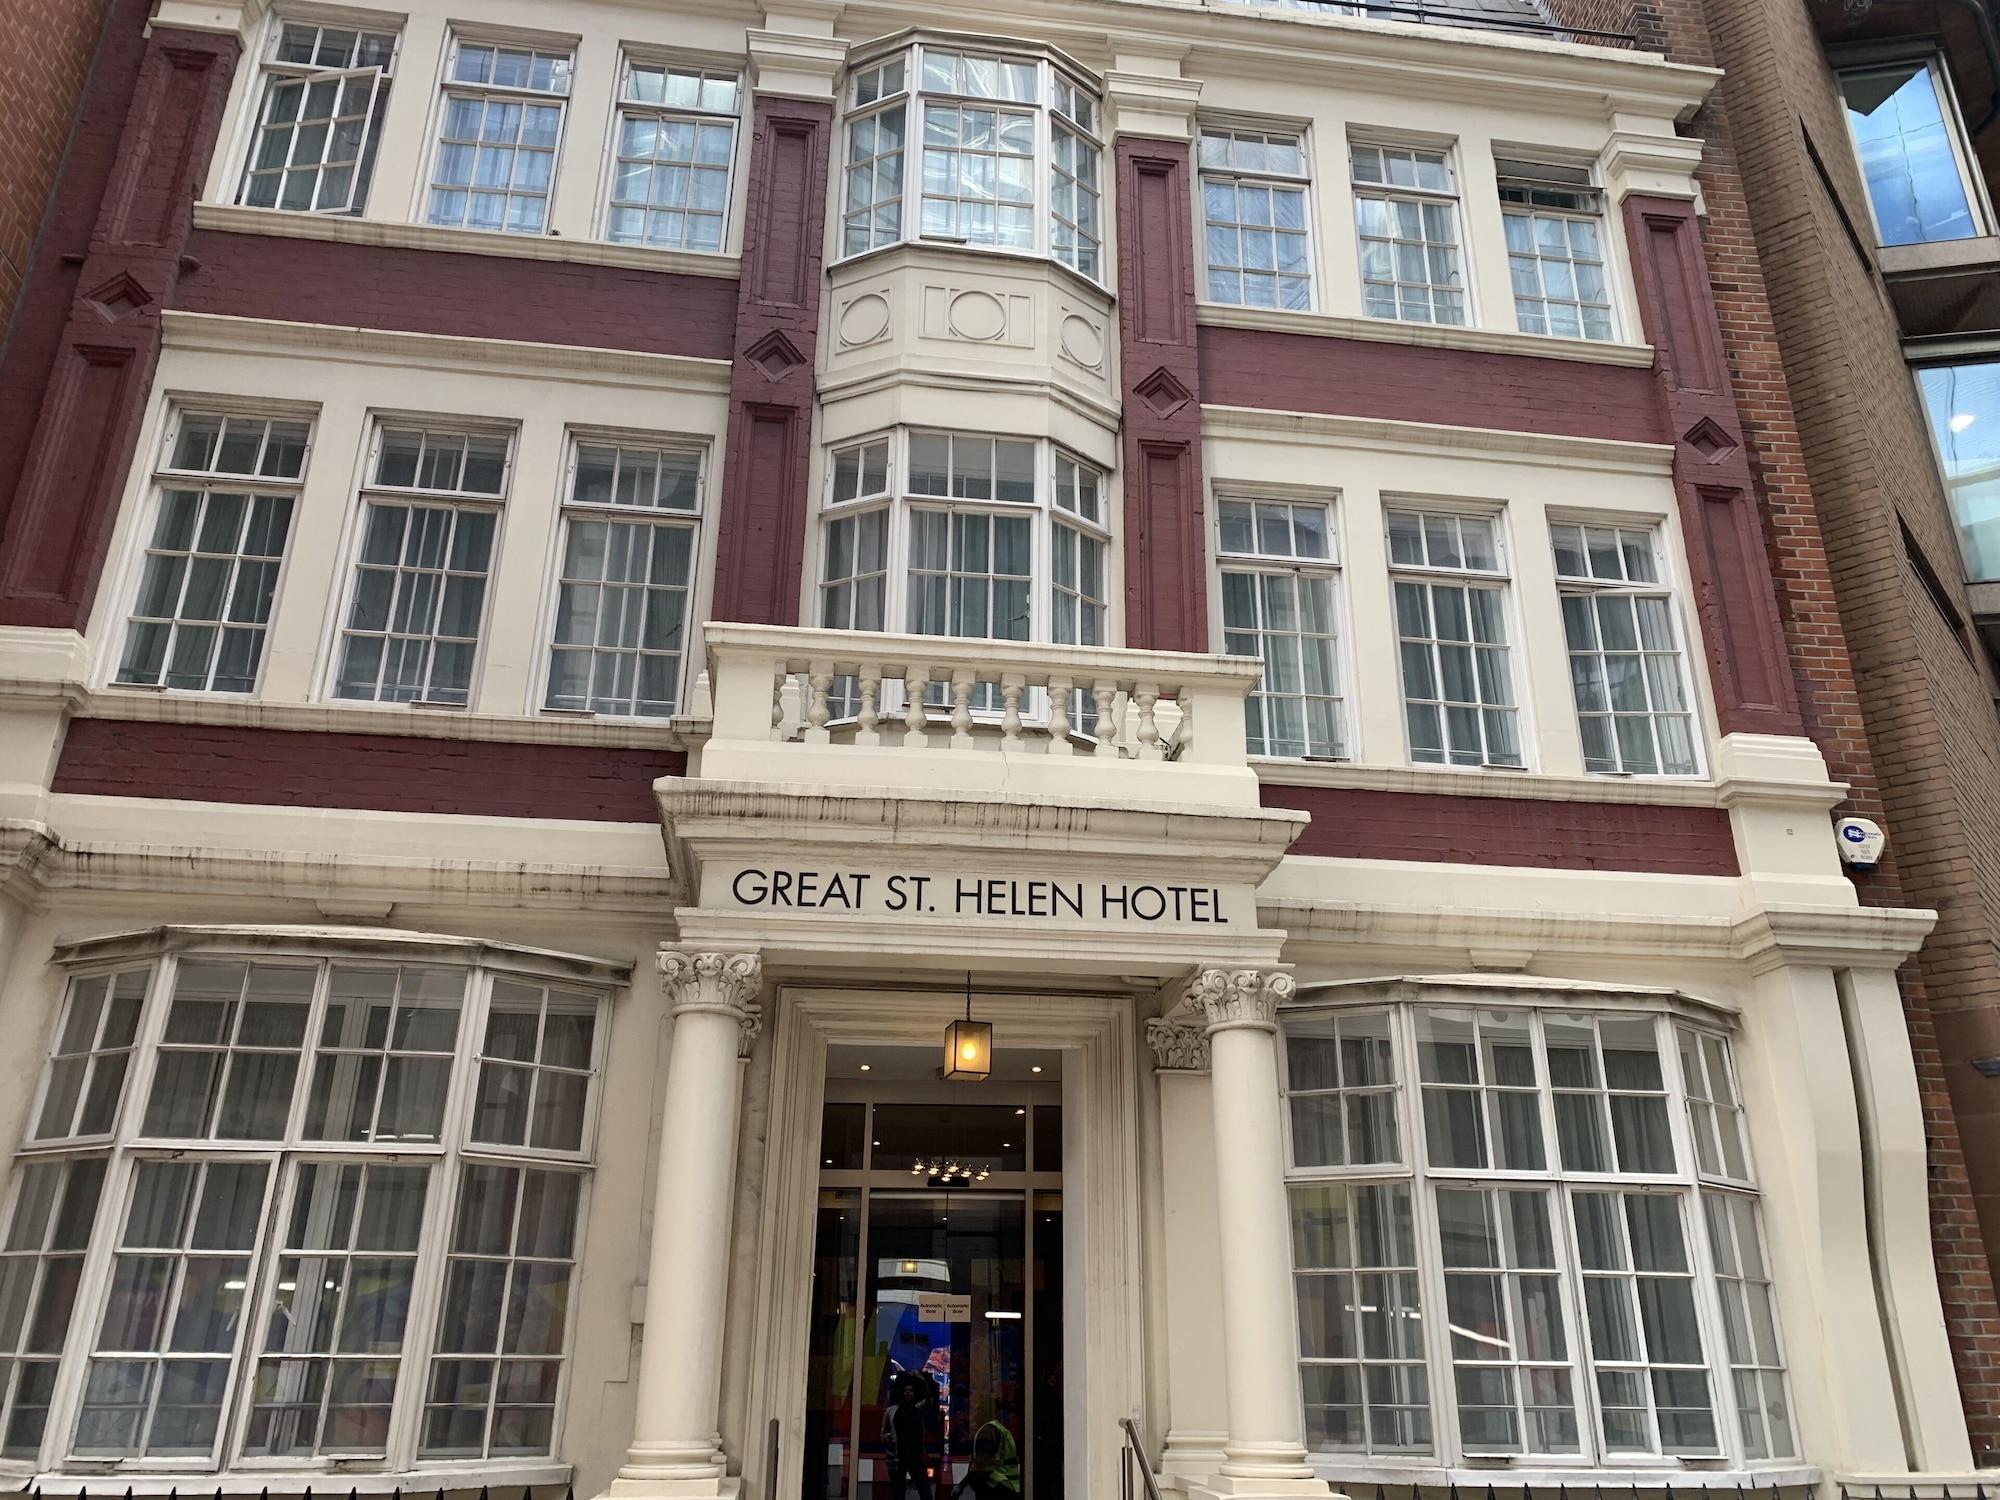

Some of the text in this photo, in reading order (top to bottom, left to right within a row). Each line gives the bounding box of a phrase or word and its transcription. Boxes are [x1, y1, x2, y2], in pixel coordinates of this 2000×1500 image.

[732, 869, 1228, 923] GREAT ST. HELEN HOTEL
